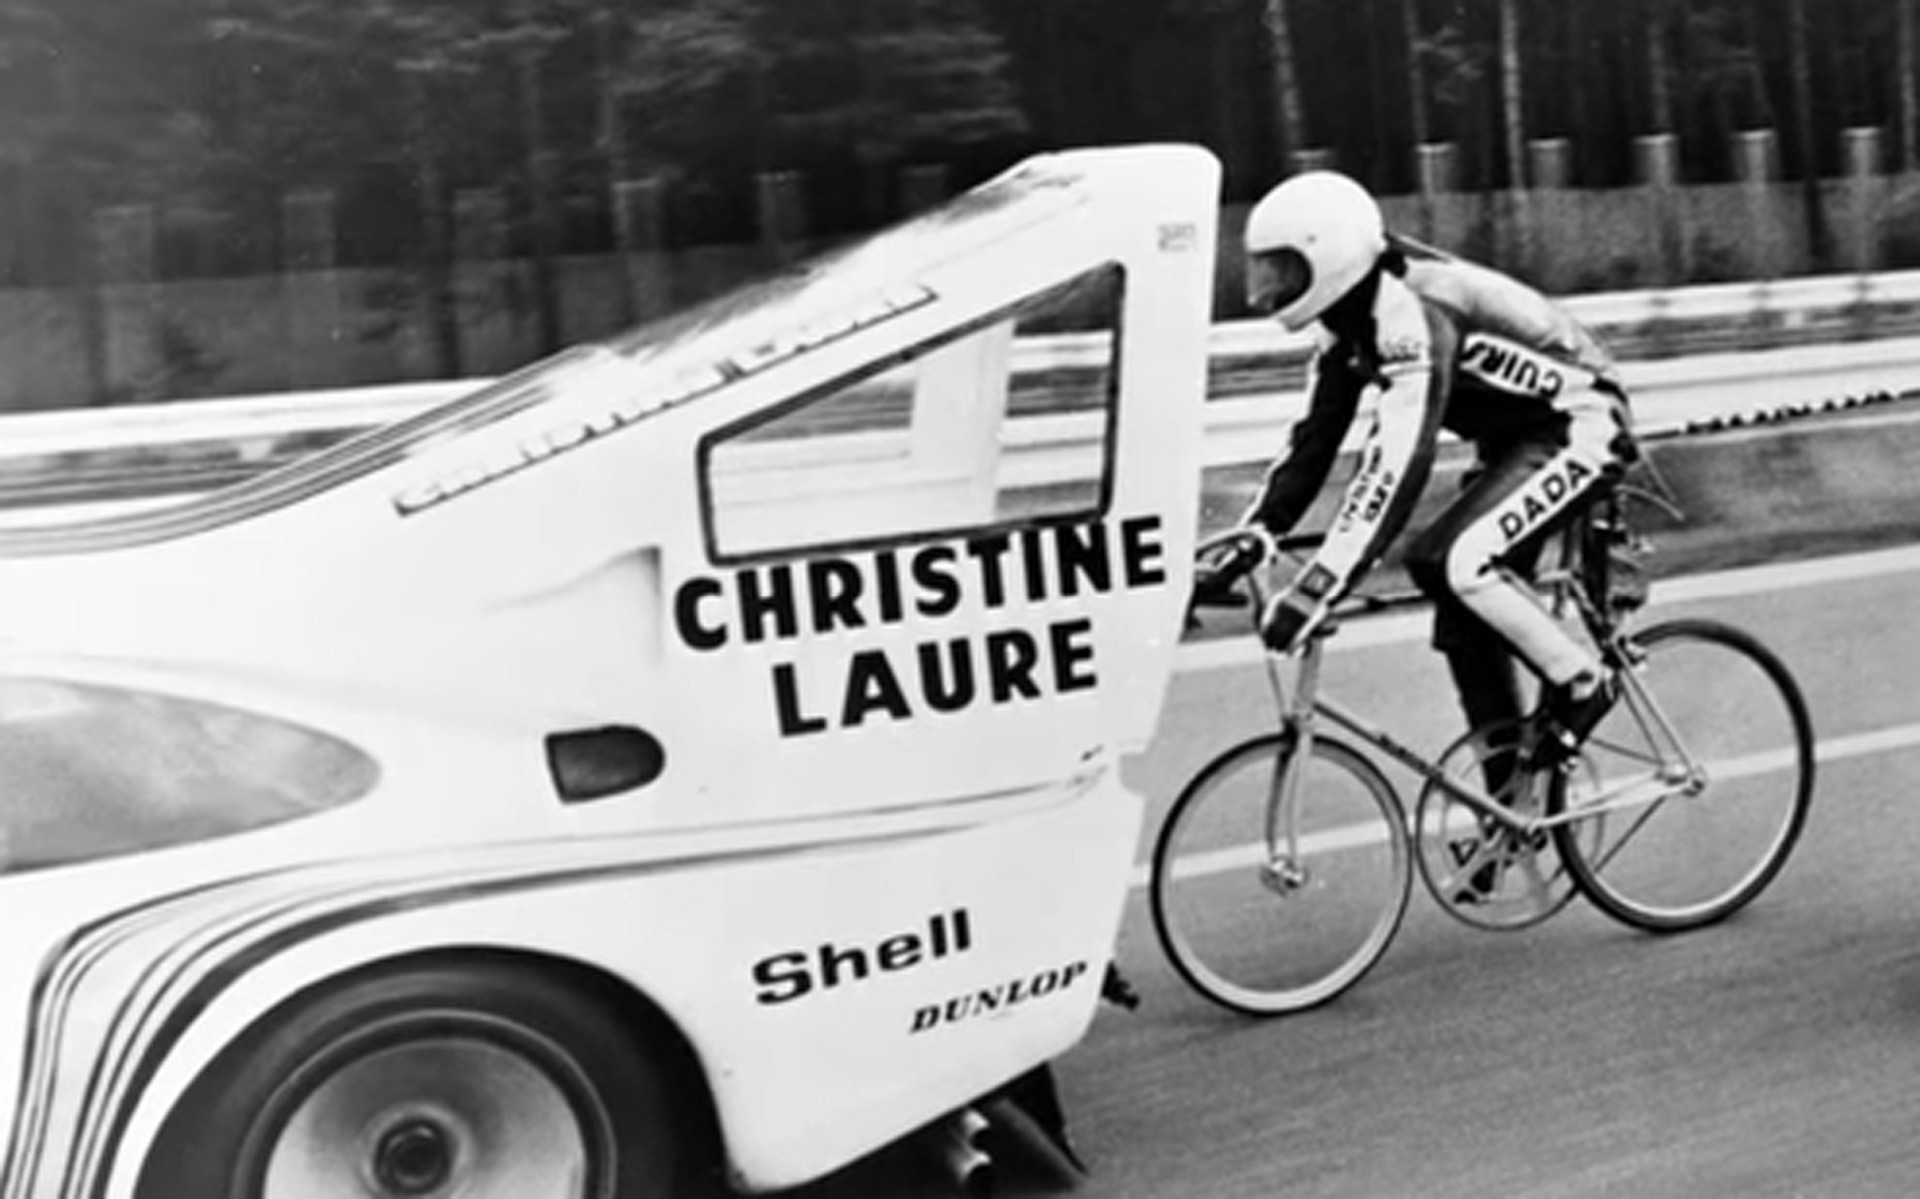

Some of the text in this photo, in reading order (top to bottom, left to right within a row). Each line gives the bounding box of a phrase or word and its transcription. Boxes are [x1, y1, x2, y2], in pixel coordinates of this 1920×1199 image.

[1499, 458, 1592, 540] DADA
[674, 515, 1165, 651] CHRISTINE
[772, 618, 1097, 737] LAURE
[752, 908, 971, 1005] Shell
[908, 961, 1087, 1034] DUNLOP
